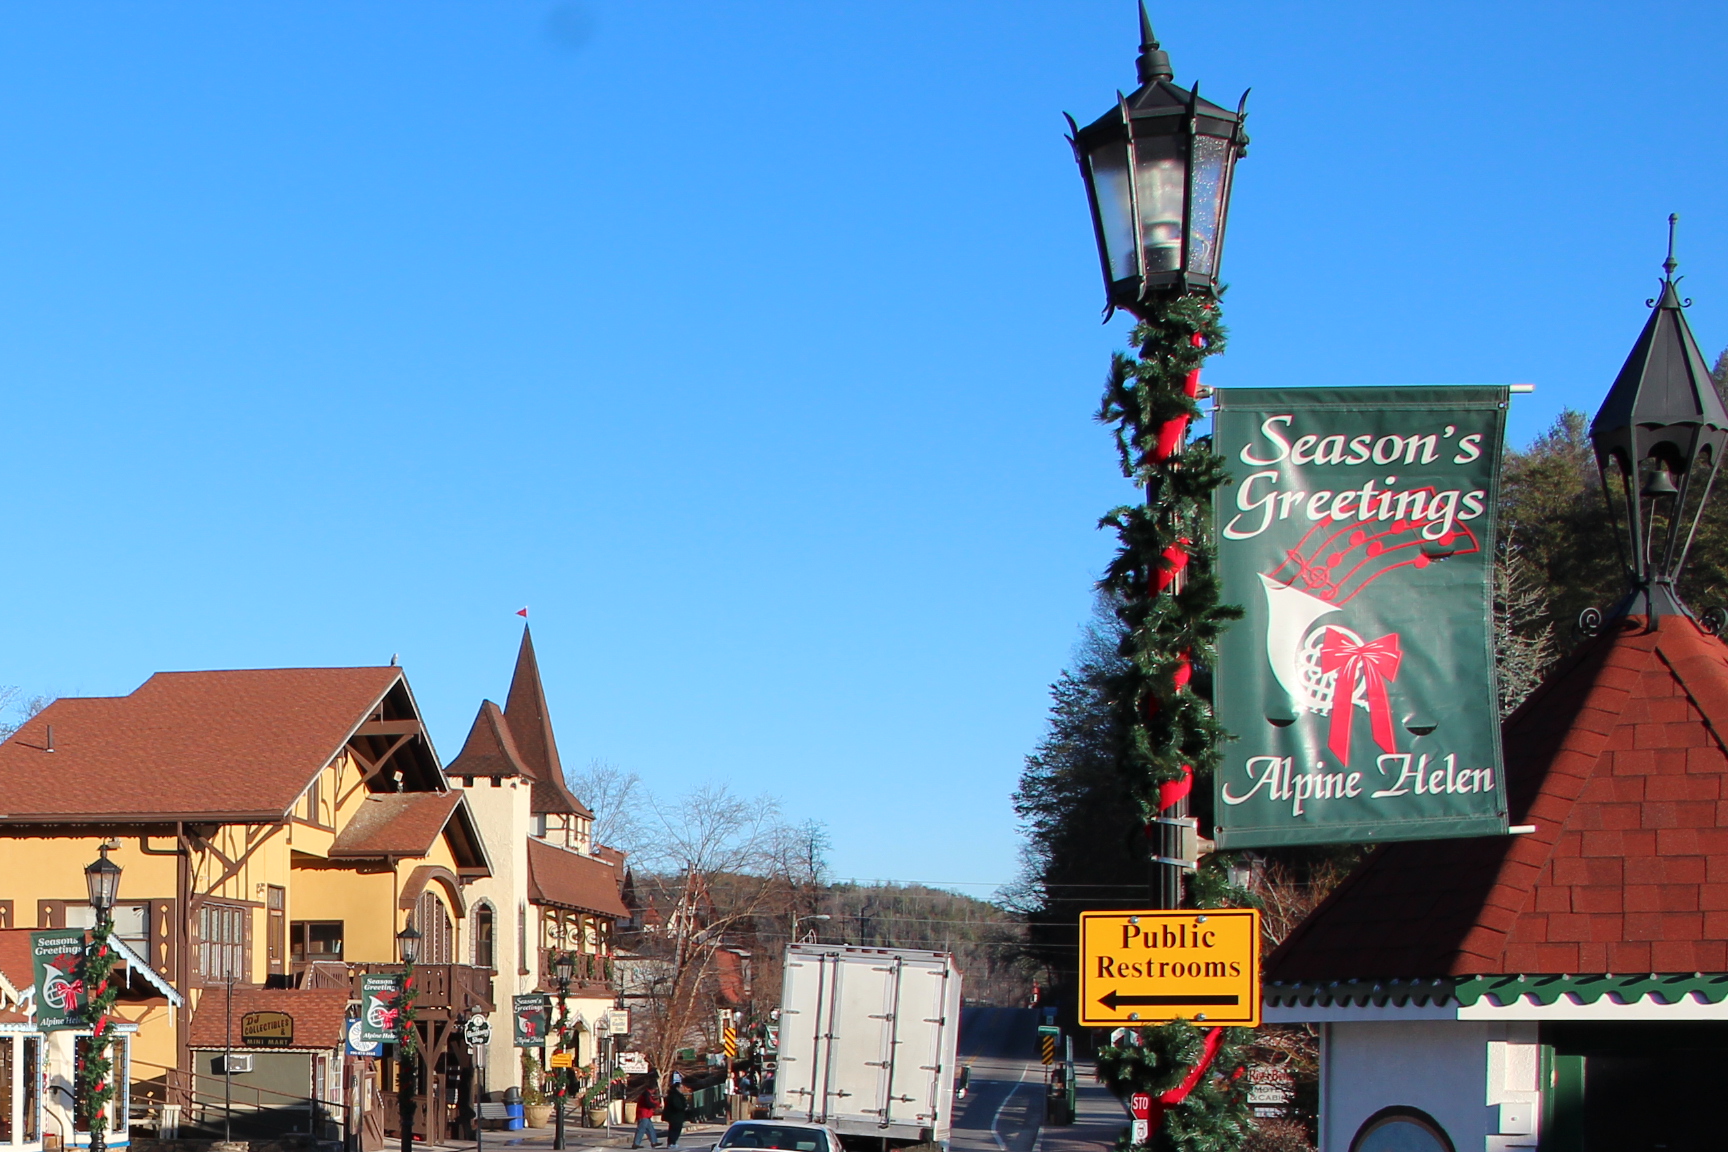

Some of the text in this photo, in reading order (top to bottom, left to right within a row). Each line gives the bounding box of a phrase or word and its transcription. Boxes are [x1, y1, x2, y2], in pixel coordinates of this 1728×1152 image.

[1240, 415, 1484, 466] Season's
[1222, 470, 1485, 540] Greetings
[1222, 753, 1495, 816] Alpine Helen
[1120, 923, 1216, 949] Public
[34, 945, 82, 956] Greetings
[1095, 955, 1241, 979] Restrooms
[40, 1015, 82, 1028] Alpine Hel
[245, 1014, 260, 1026] DJ
[245, 1018, 289, 1035] COLLECTIBLES
[363, 1032, 382, 1040] Alpine
[1254, 1086, 1281, 1094] MOTE
[1133, 1097, 1149, 1110] STO
